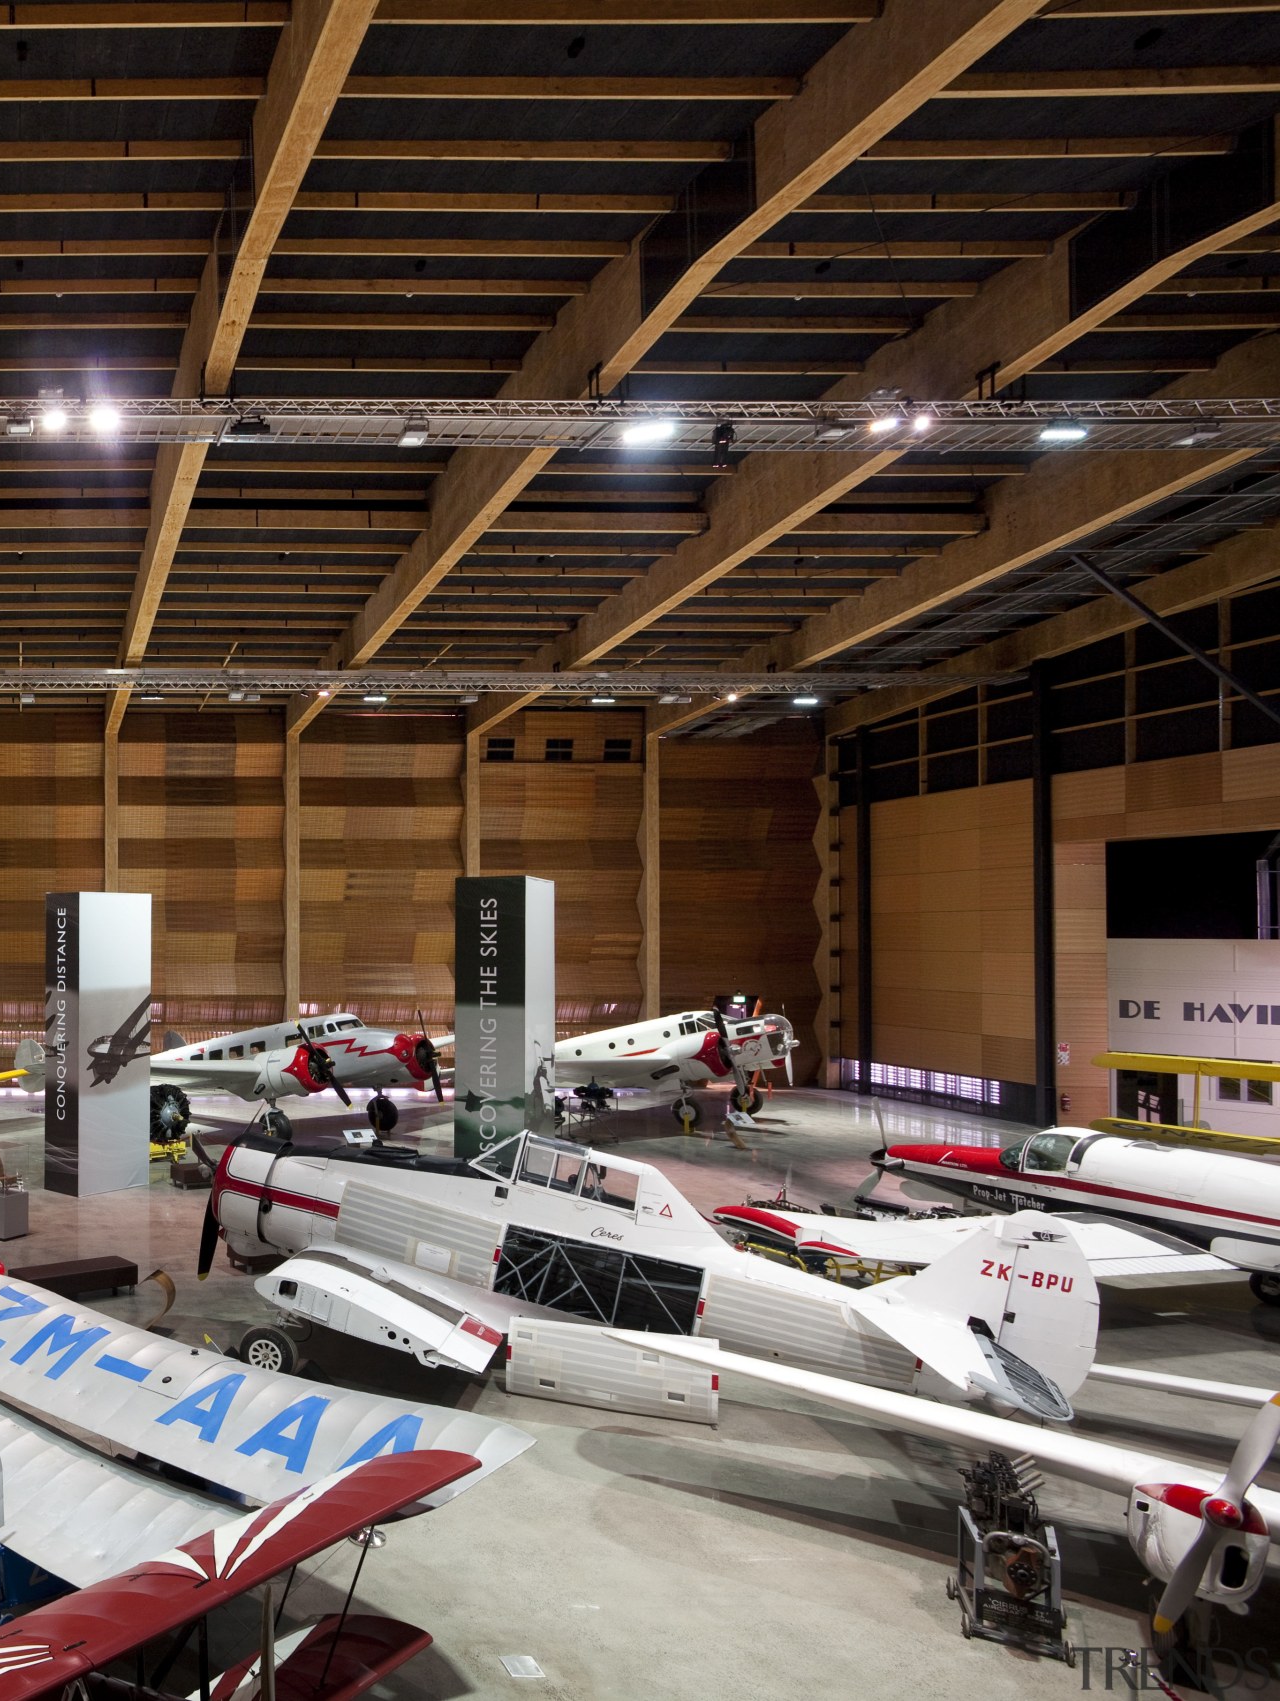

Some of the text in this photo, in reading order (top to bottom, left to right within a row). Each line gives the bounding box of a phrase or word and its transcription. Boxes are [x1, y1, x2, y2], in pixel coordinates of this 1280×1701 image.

[480, 898, 498, 957] SKIES
[480, 966, 497, 1010] THE
[56, 907, 67, 1121] CONQUERING DISTANCE
[1119, 1000, 1160, 1020] DE
[972, 1185, 1007, 1202] Prop-Jet
[590, 1227, 624, 1241] Ceres
[980, 1259, 1073, 1293] ZK-BPU
